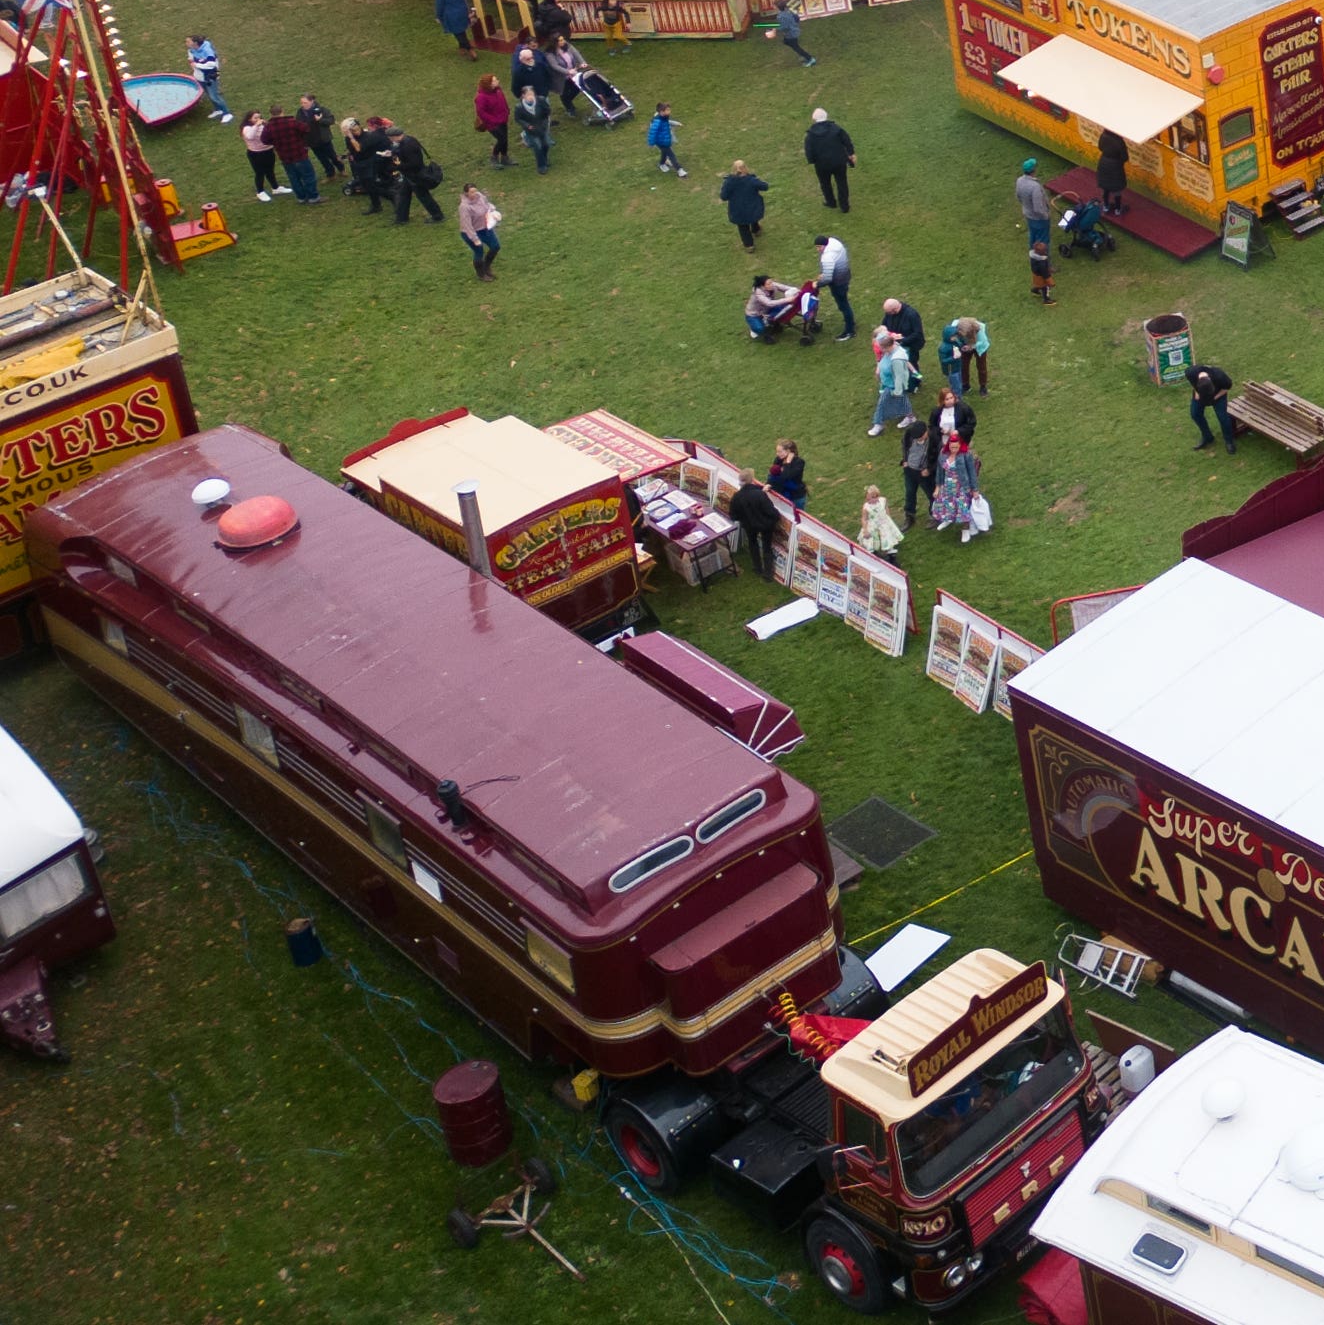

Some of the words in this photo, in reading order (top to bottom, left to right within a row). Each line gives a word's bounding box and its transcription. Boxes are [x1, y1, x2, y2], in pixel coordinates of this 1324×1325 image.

[963, 40, 988, 66] £3
[1263, 27, 1320, 64] CARTERS
[1272, 50, 1316, 79] STEAM
[1279, 69, 1312, 95] FAIR
[1275, 145, 1294, 161] ON
[0, 385, 167, 486] TERS
[494, 496, 623, 572] CARTERS
[576, 526, 627, 560] FAIR
[1065, 774, 1130, 815] AUTOMATIC
[1147, 796, 1255, 857] Super
[911, 1029, 973, 1092] ROYAL
[970, 975, 1047, 1037] WINDSOR
